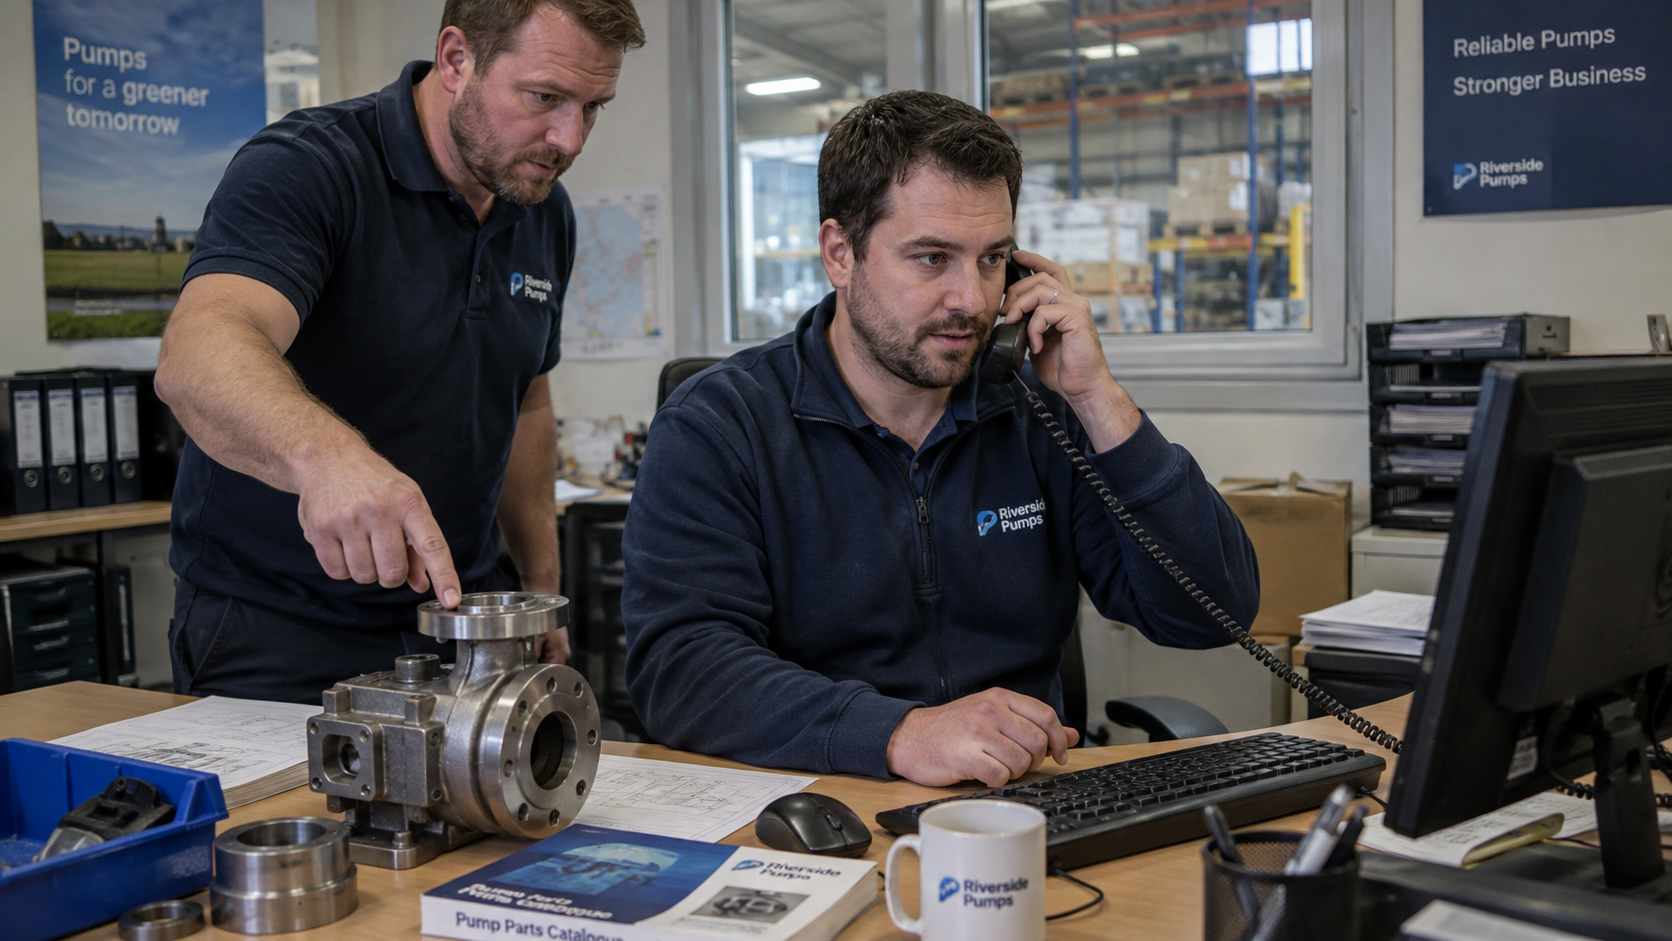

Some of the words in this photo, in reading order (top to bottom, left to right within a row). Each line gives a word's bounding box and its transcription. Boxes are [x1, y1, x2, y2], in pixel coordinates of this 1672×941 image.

[63, 36, 147, 73] Pumps
[1454, 32, 1535, 58] Reliable
[1541, 28, 1616, 49] Pumps
[64, 68, 97, 96] for
[102, 78, 116, 99] a
[122, 80, 210, 107] greener
[1453, 73, 1544, 96] Stronger
[1549, 65, 1646, 88] Business
[66, 103, 180, 136] tomorrow
[1480, 158, 1544, 175] Riverside
[1480, 172, 1528, 189] Pumps
[998, 498, 1046, 519] Riversid
[1001, 514, 1044, 533] Pumps
[963, 877, 1028, 893] Riverside
[963, 894, 1014, 910] Pumps
[456, 911, 501, 933] Pump
[505, 919, 544, 937] Parts
